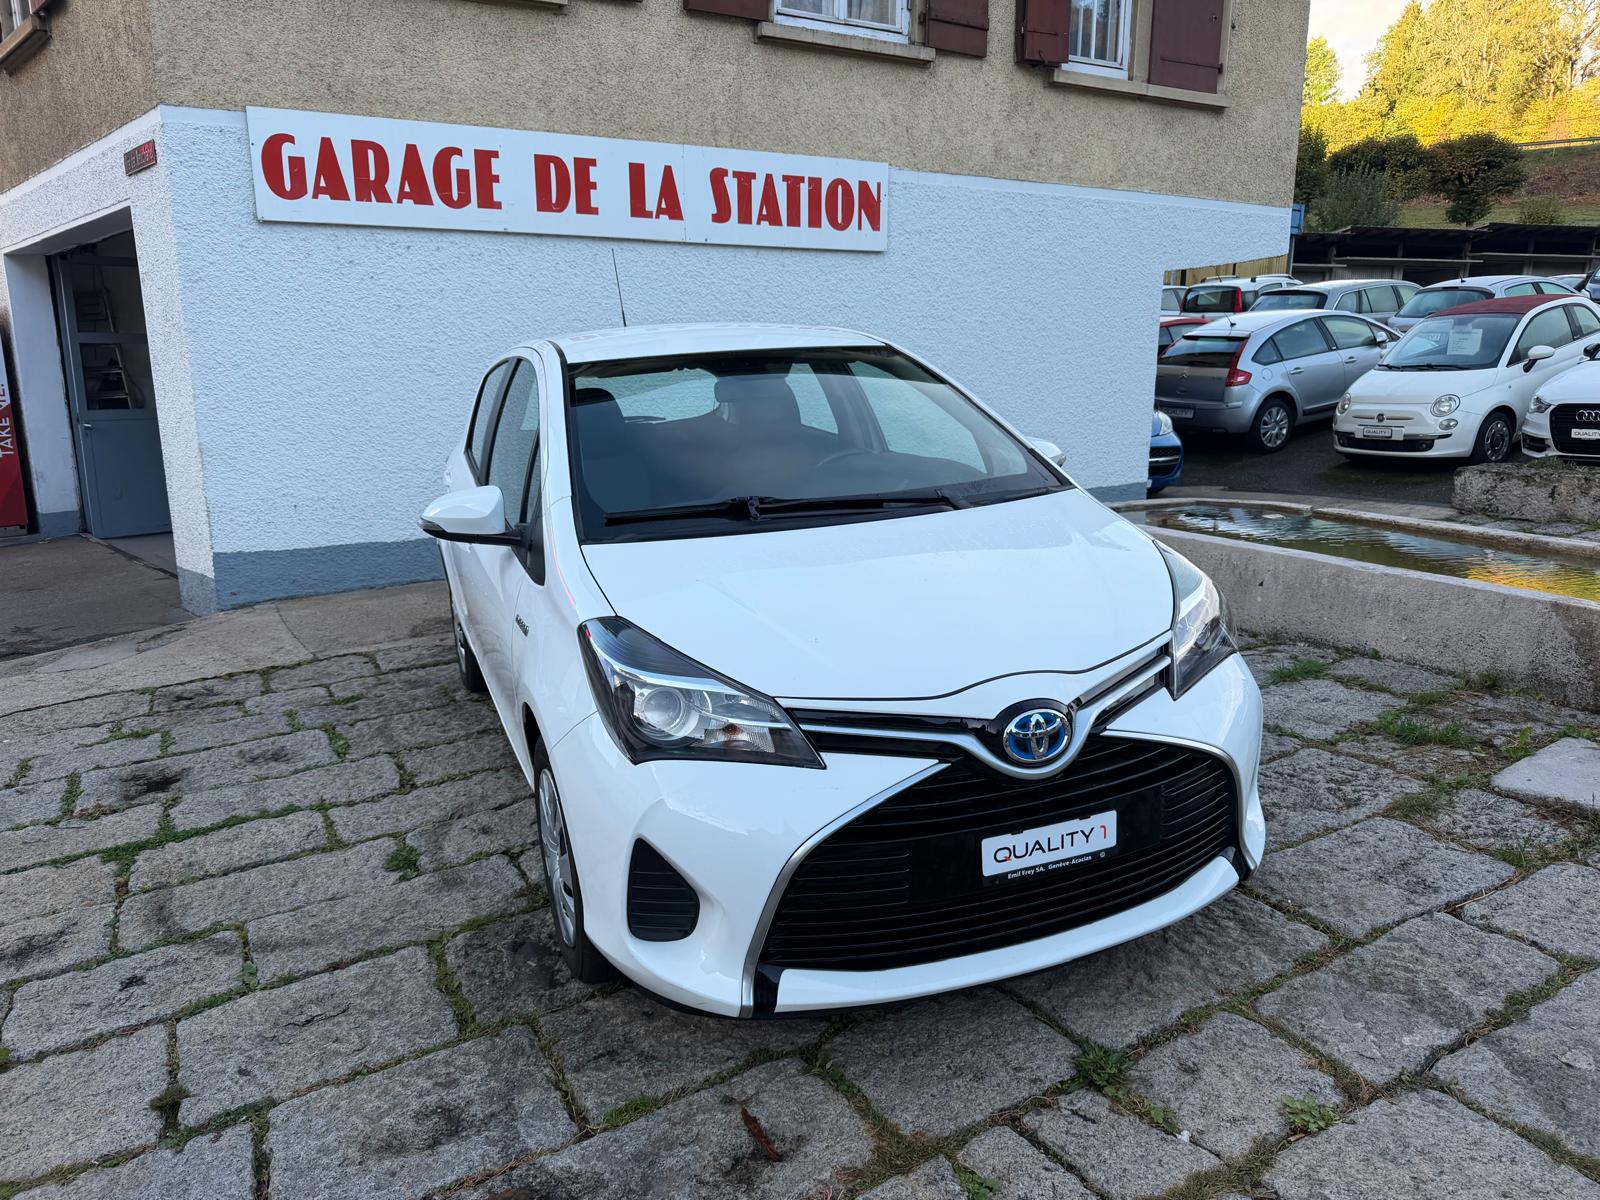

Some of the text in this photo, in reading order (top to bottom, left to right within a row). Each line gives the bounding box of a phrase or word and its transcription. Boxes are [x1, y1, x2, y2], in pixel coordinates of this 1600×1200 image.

[261, 133, 881, 232] GARAGE DE LA STATION
[0, 417, 14, 458] TAKE
[994, 825, 1107, 863] QUALITY 1
[1007, 870, 1021, 879] Emil
[1022, 868, 1035, 876] Frey
[1048, 855, 1092, 870] Genève-Acacias
